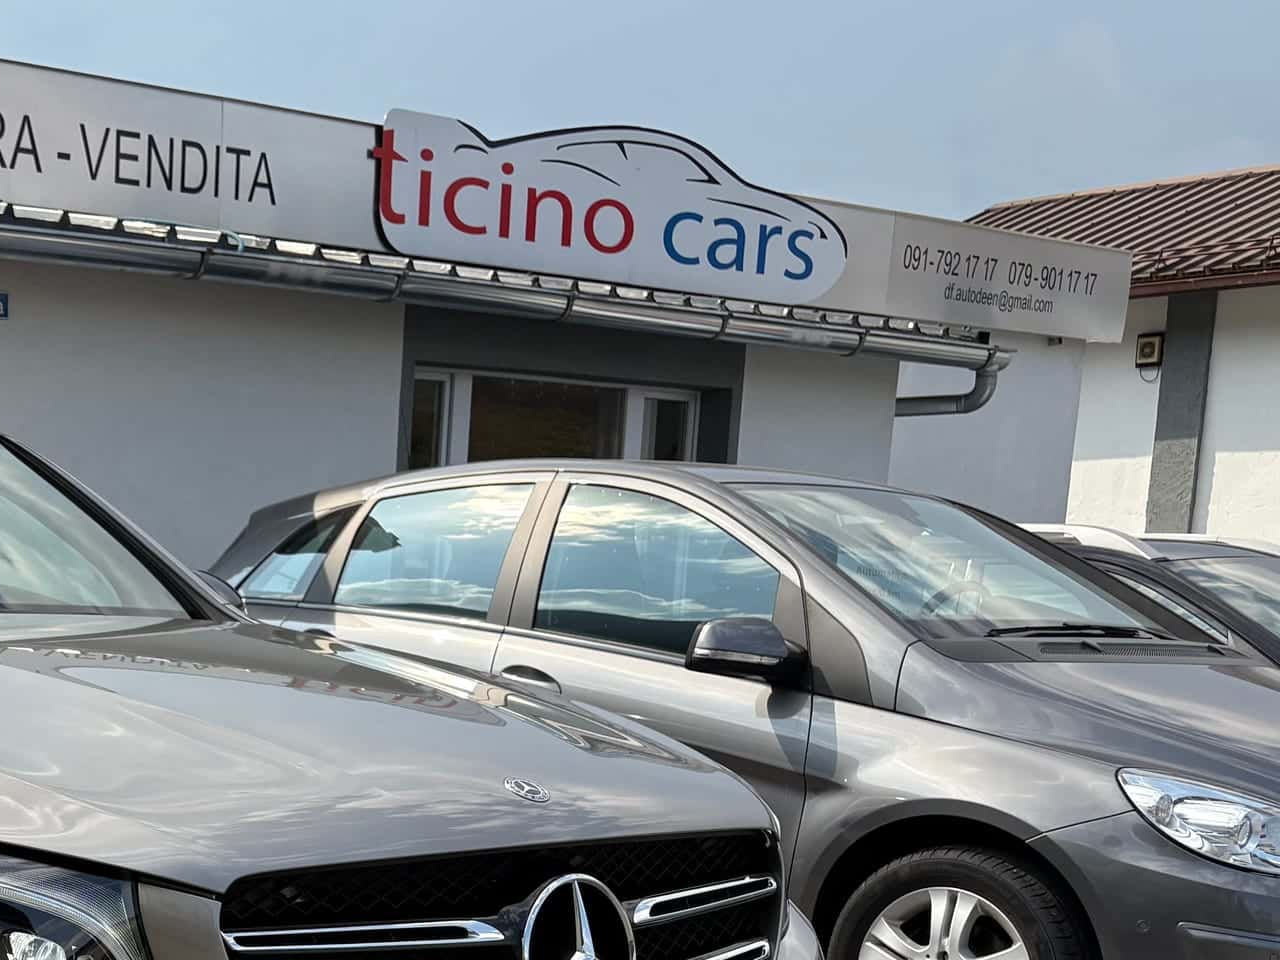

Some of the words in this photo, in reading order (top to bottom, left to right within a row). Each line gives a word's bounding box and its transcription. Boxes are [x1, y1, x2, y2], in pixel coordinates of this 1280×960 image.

[79, 122, 277, 207] VENDITA
[372, 129, 634, 254] ticino
[662, 211, 815, 281] cars
[903, 243, 961, 277] 091-792
[943, 281, 1054, 313] df.autodeen@gmail.com
